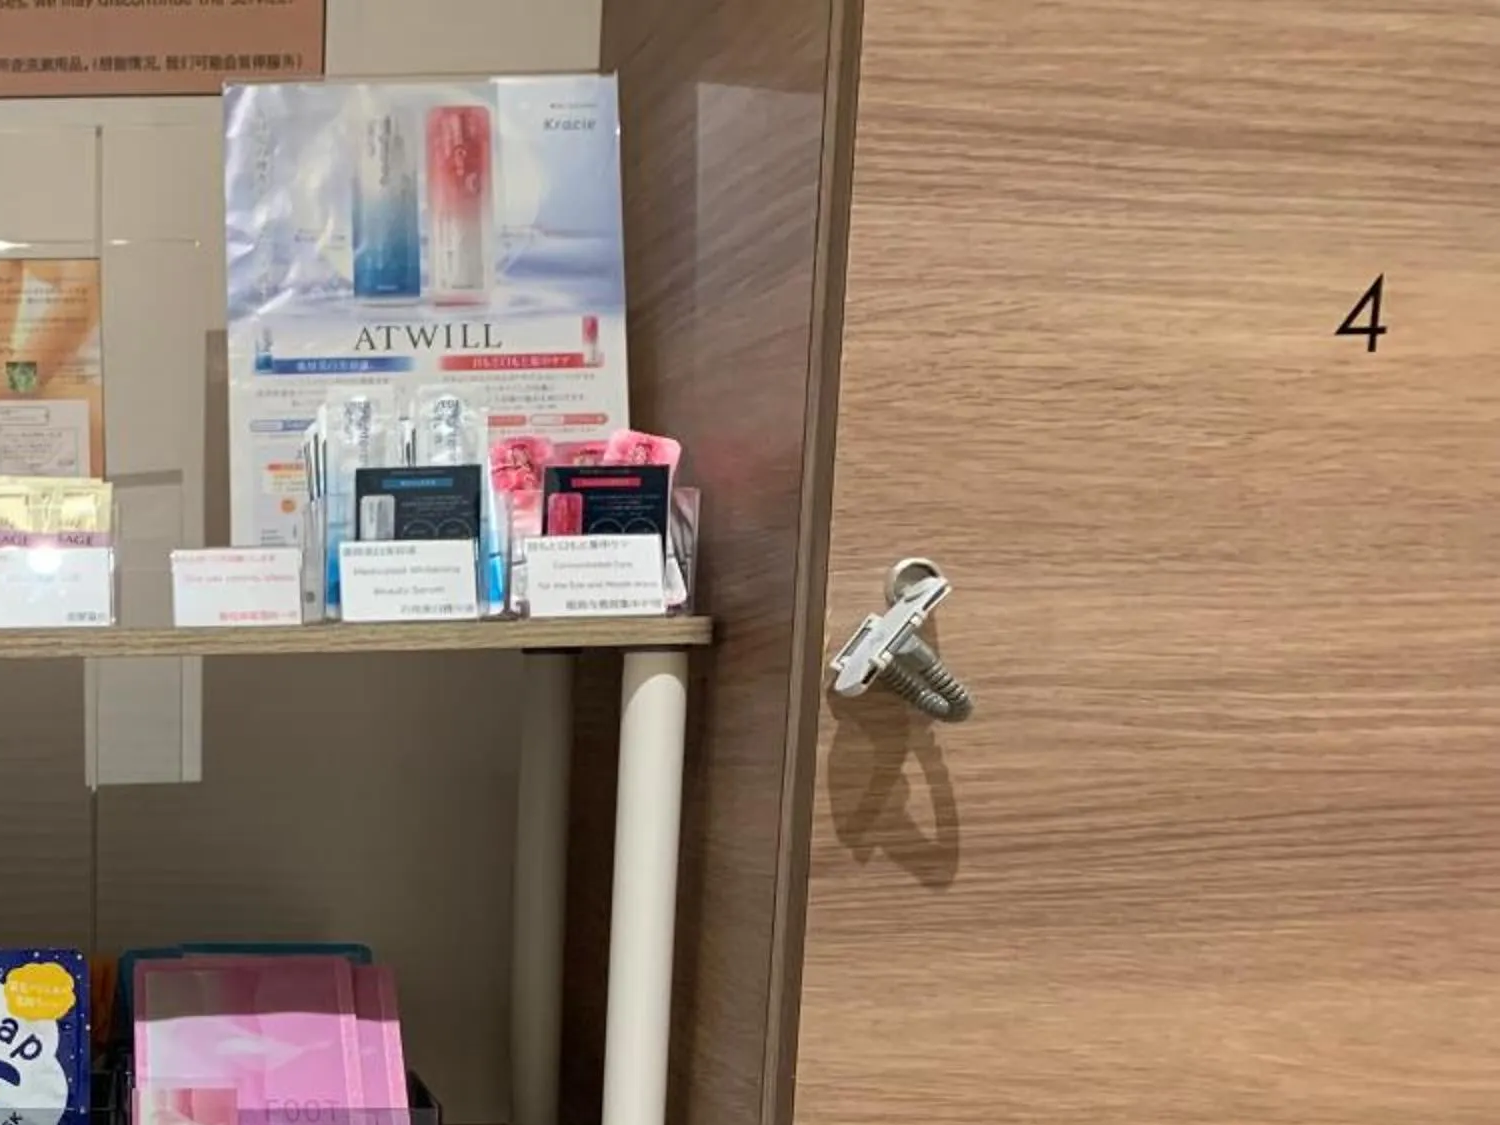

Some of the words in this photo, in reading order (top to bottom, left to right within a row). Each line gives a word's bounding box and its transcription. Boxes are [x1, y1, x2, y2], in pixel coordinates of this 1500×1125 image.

[543, 117, 597, 131] Kracie
[1335, 274, 1388, 353] 4
[354, 323, 503, 351] ATWILL
[266, 1099, 341, 1123] FOOT
